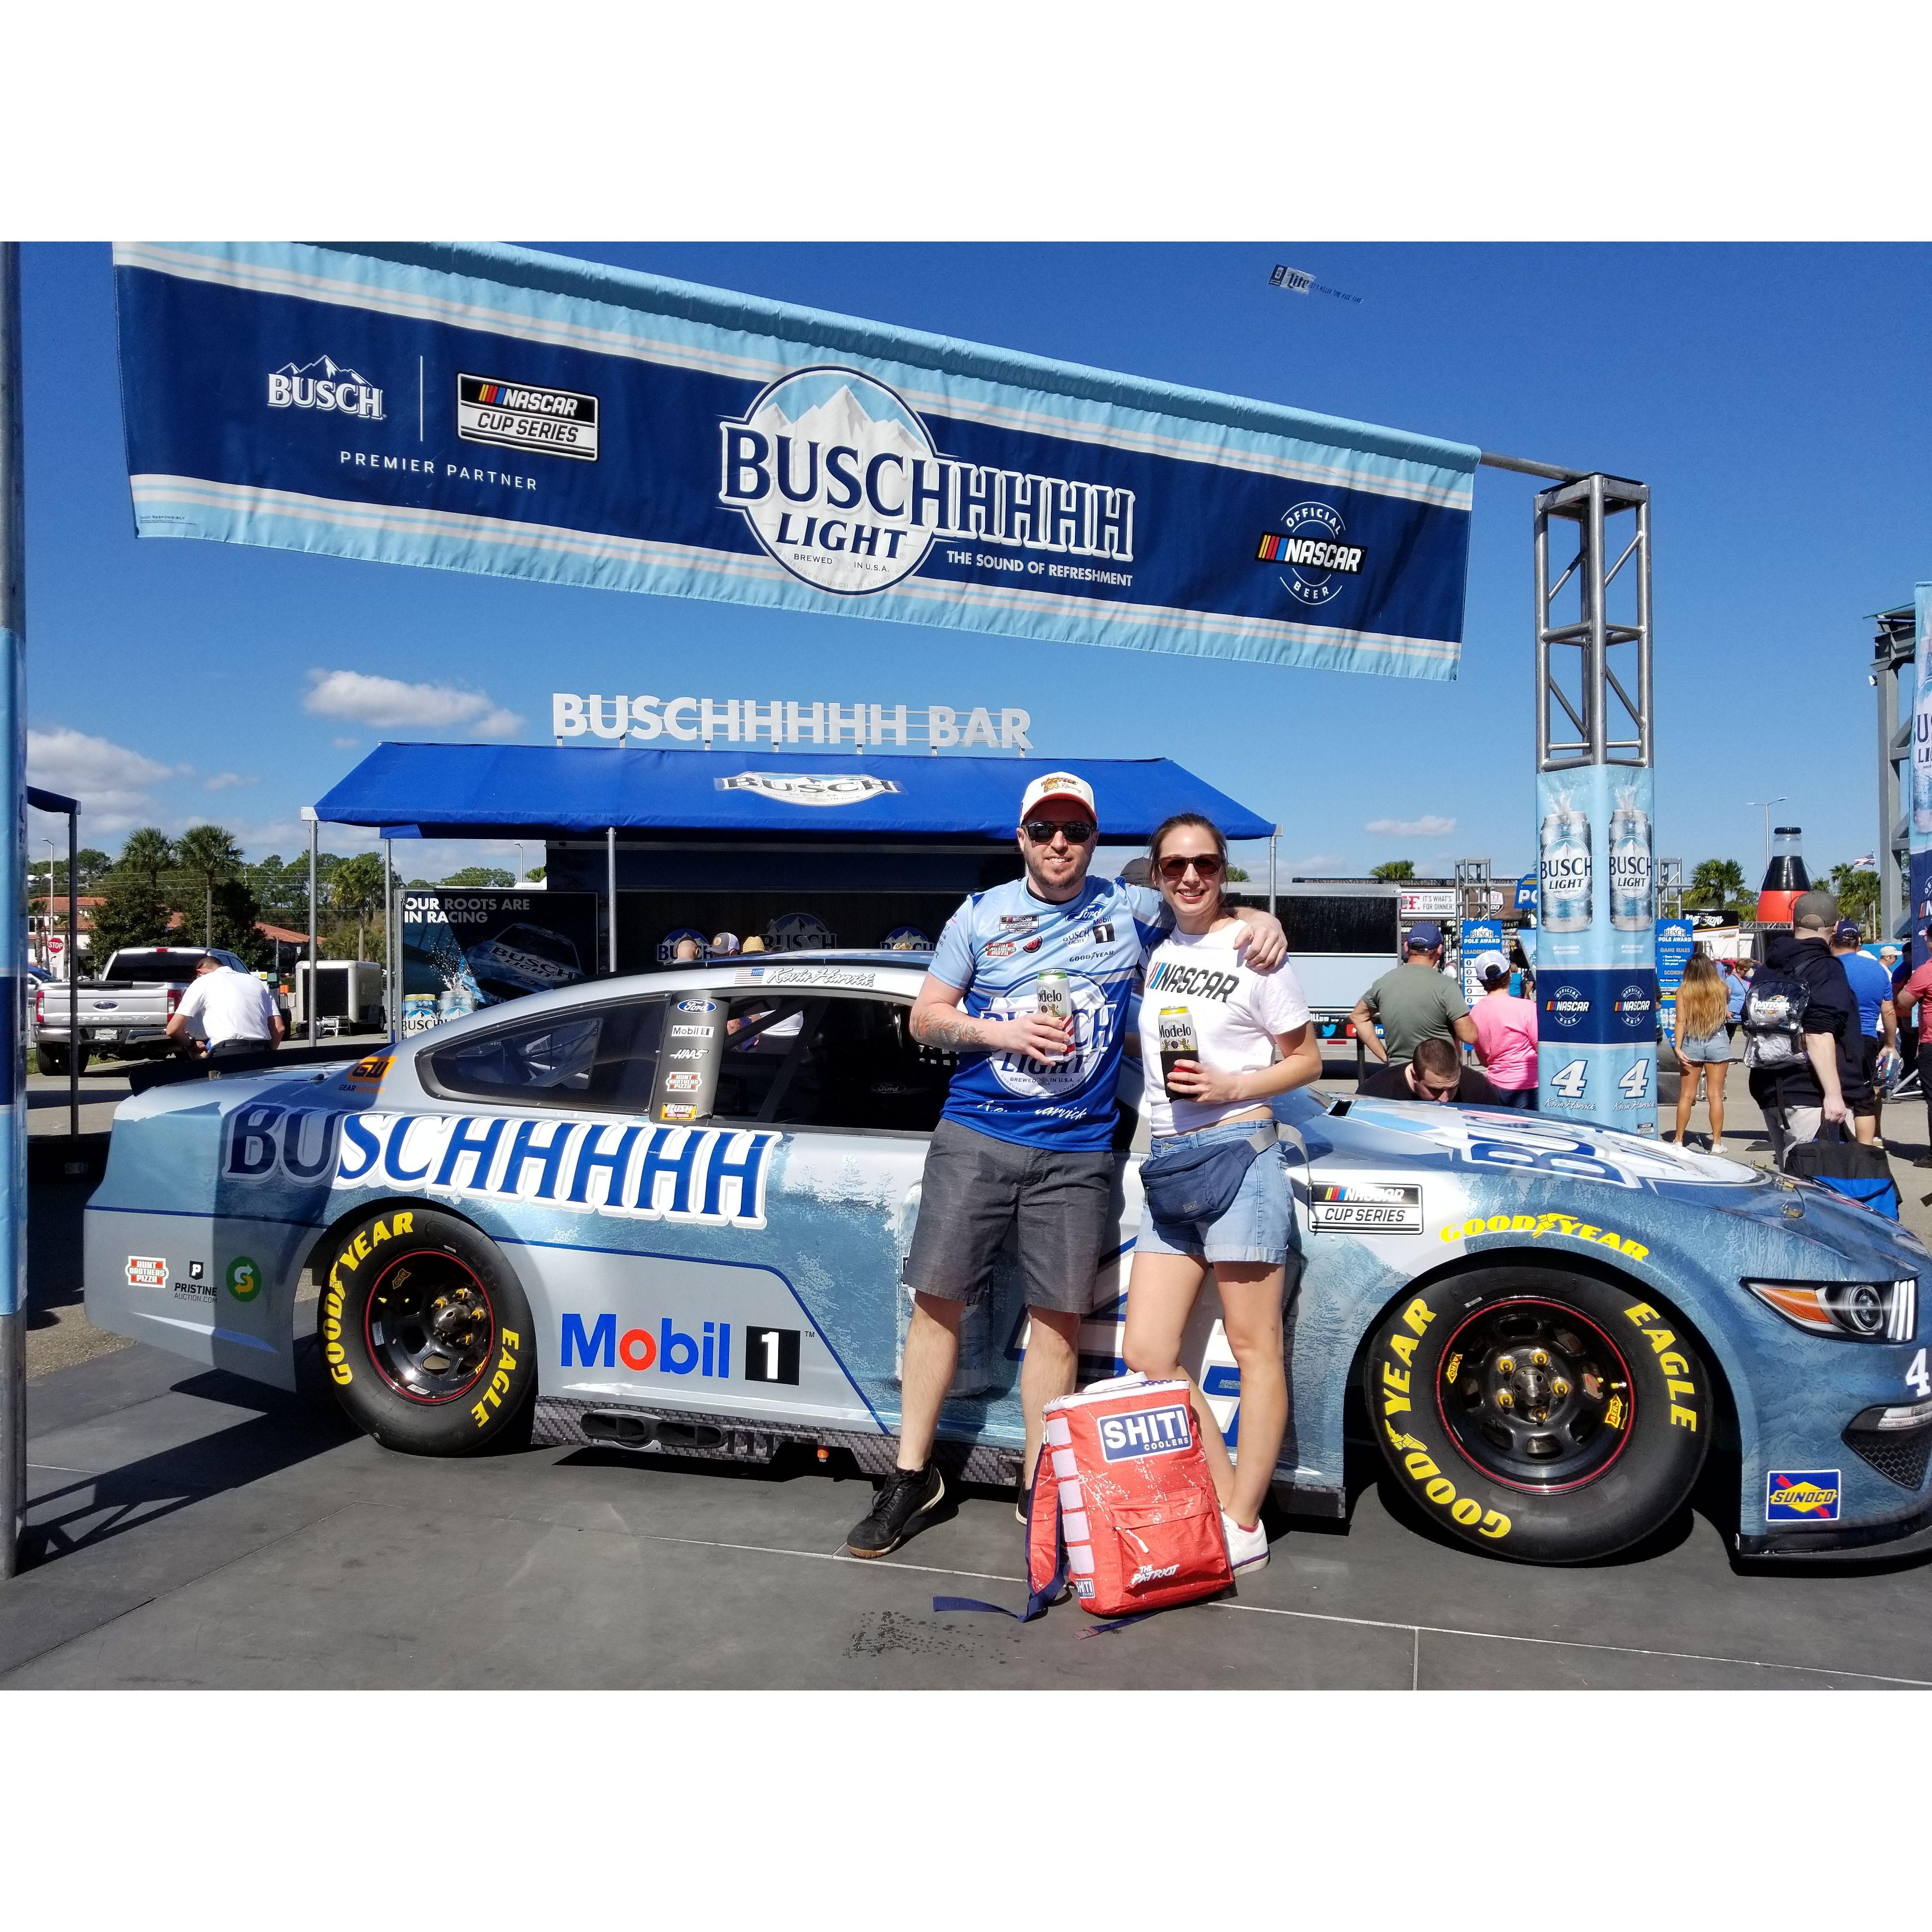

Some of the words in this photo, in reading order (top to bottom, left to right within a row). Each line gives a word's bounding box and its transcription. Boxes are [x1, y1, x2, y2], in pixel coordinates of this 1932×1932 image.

[1288, 273, 1310, 288] Lite
[267, 373, 384, 420] BUSCH
[502, 387, 578, 417] NASCAR
[478, 412, 514, 431] CUP
[516, 416, 579, 443] SERIES
[340, 451, 436, 474] PREMIER
[447, 464, 538, 491] PARTNER
[720, 421, 1136, 562] BUSCHHHHH
[1286, 506, 1342, 536] OFFICIAL
[775, 512, 908, 560] LIGHT
[794, 553, 833, 564] BREWED
[866, 564, 889, 572] U.S.A.
[1285, 538, 1362, 572] NASCAR
[947, 550, 972, 565] THE
[976, 553, 1024, 572] SOUND
[1028, 560, 1045, 574] OF
[1048, 563, 1133, 587] REFRESHMENT
[1294, 581, 1330, 599] BEER
[553, 692, 907, 746] BUSCHHHHH
[929, 705, 1034, 749] BAR
[722, 776, 902, 793] BUSCH
[1541, 856, 1592, 880] BUSCH
[1610, 855, 1652, 877] BUSCH
[1549, 878, 1584, 889] LIGHT
[1618, 877, 1646, 887] LIGHT
[405, 898, 440, 910] OUR
[445, 898, 497, 910] ROOTS
[501, 899, 530, 910] ARE
[1074, 905, 1102, 920] Ford
[404, 911, 422, 923] IN
[427, 911, 488, 923] RACING
[1093, 915, 1111, 925] Mobil
[490, 946, 575, 979] BUSCH
[1069, 950, 1114, 962] GOODYEAR
[505, 959, 556, 978] LIGHT
[767, 967, 814, 984] Kevin
[1155, 963, 1240, 1003] NASCAR
[1037, 989, 1062, 1002] odelo
[1556, 988, 1579, 998] OFFICIAL
[1623, 987, 1643, 998] OFFICIAL
[684, 1000, 709, 1011] Ford
[1556, 1001, 1589, 1012] NASCAR
[1623, 1000, 1651, 1011] NASCAR
[1159, 1024, 1191, 1038] Modelo
[1375, 1026, 1384, 1035] in
[1551, 1058, 1588, 1099] 4
[1618, 1058, 1650, 1099] 4
[665, 1104, 694, 1114] RUSH
[1544, 1098, 1565, 1108] Kevin
[1613, 1101, 1631, 1111] Kevin
[1035, 1106, 1087, 1120] arvick
[222, 1104, 782, 1228] BUSCHHHHH
[1325, 1208, 1354, 1220] CUP
[1355, 1208, 1406, 1222] SERIES
[1440, 1212, 1650, 1262] GOODYEAR
[129, 1267, 165, 1276] BROTHERS
[174, 1282, 218, 1296] PRISTINE
[174, 1293, 218, 1303] AUCTION.COM
[323, 1211, 414, 1385] GOODYEAR
[561, 1313, 730, 1378] Mobil
[1450, 1356, 1459, 1376] AERO
[1624, 1302, 1697, 1432] EAGLE
[1905, 1347, 1931, 1397] 4
[471, 1327, 519, 1427] EAGLE
[1382, 1298, 1512, 1538] GOODYEAR
[1610, 1401, 1619, 1423] AERO
[1104, 1410, 1188, 1449] SHITI
[1144, 1437, 1189, 1451] COOLERS
[1773, 1490, 1835, 1504] SUNOCO
[1131, 1564, 1180, 1585] PATRIOT
[1138, 1564, 1153, 1574] THE
